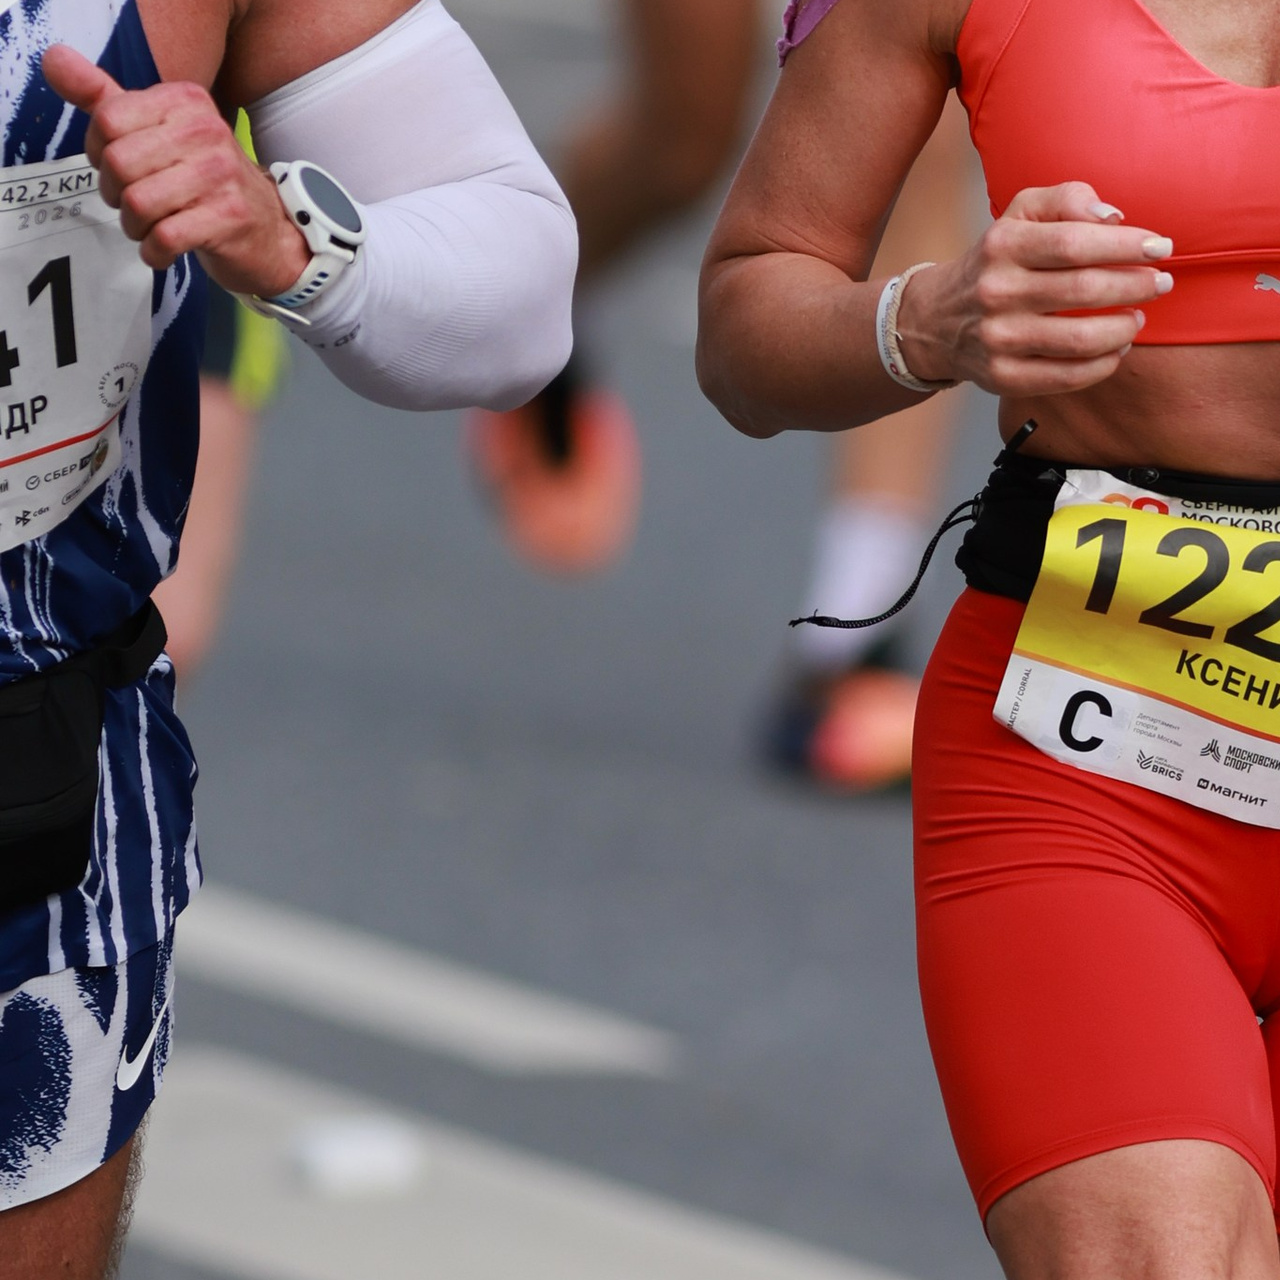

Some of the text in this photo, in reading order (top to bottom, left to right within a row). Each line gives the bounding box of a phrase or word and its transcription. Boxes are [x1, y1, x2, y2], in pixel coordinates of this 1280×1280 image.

[2, 181, 50, 204] 42,2
[18, 201, 82, 231] 2026
[114, 376, 124, 393] 1
[0, 394, 48, 440] ДР
[43, 463, 77, 483] СБЕР
[32, 506, 50, 517] сбп
[1017, 668, 1032, 697] CORRAL
[1151, 764, 1183, 782] BRICS
[1223, 757, 1253, 773] СПОРТ
